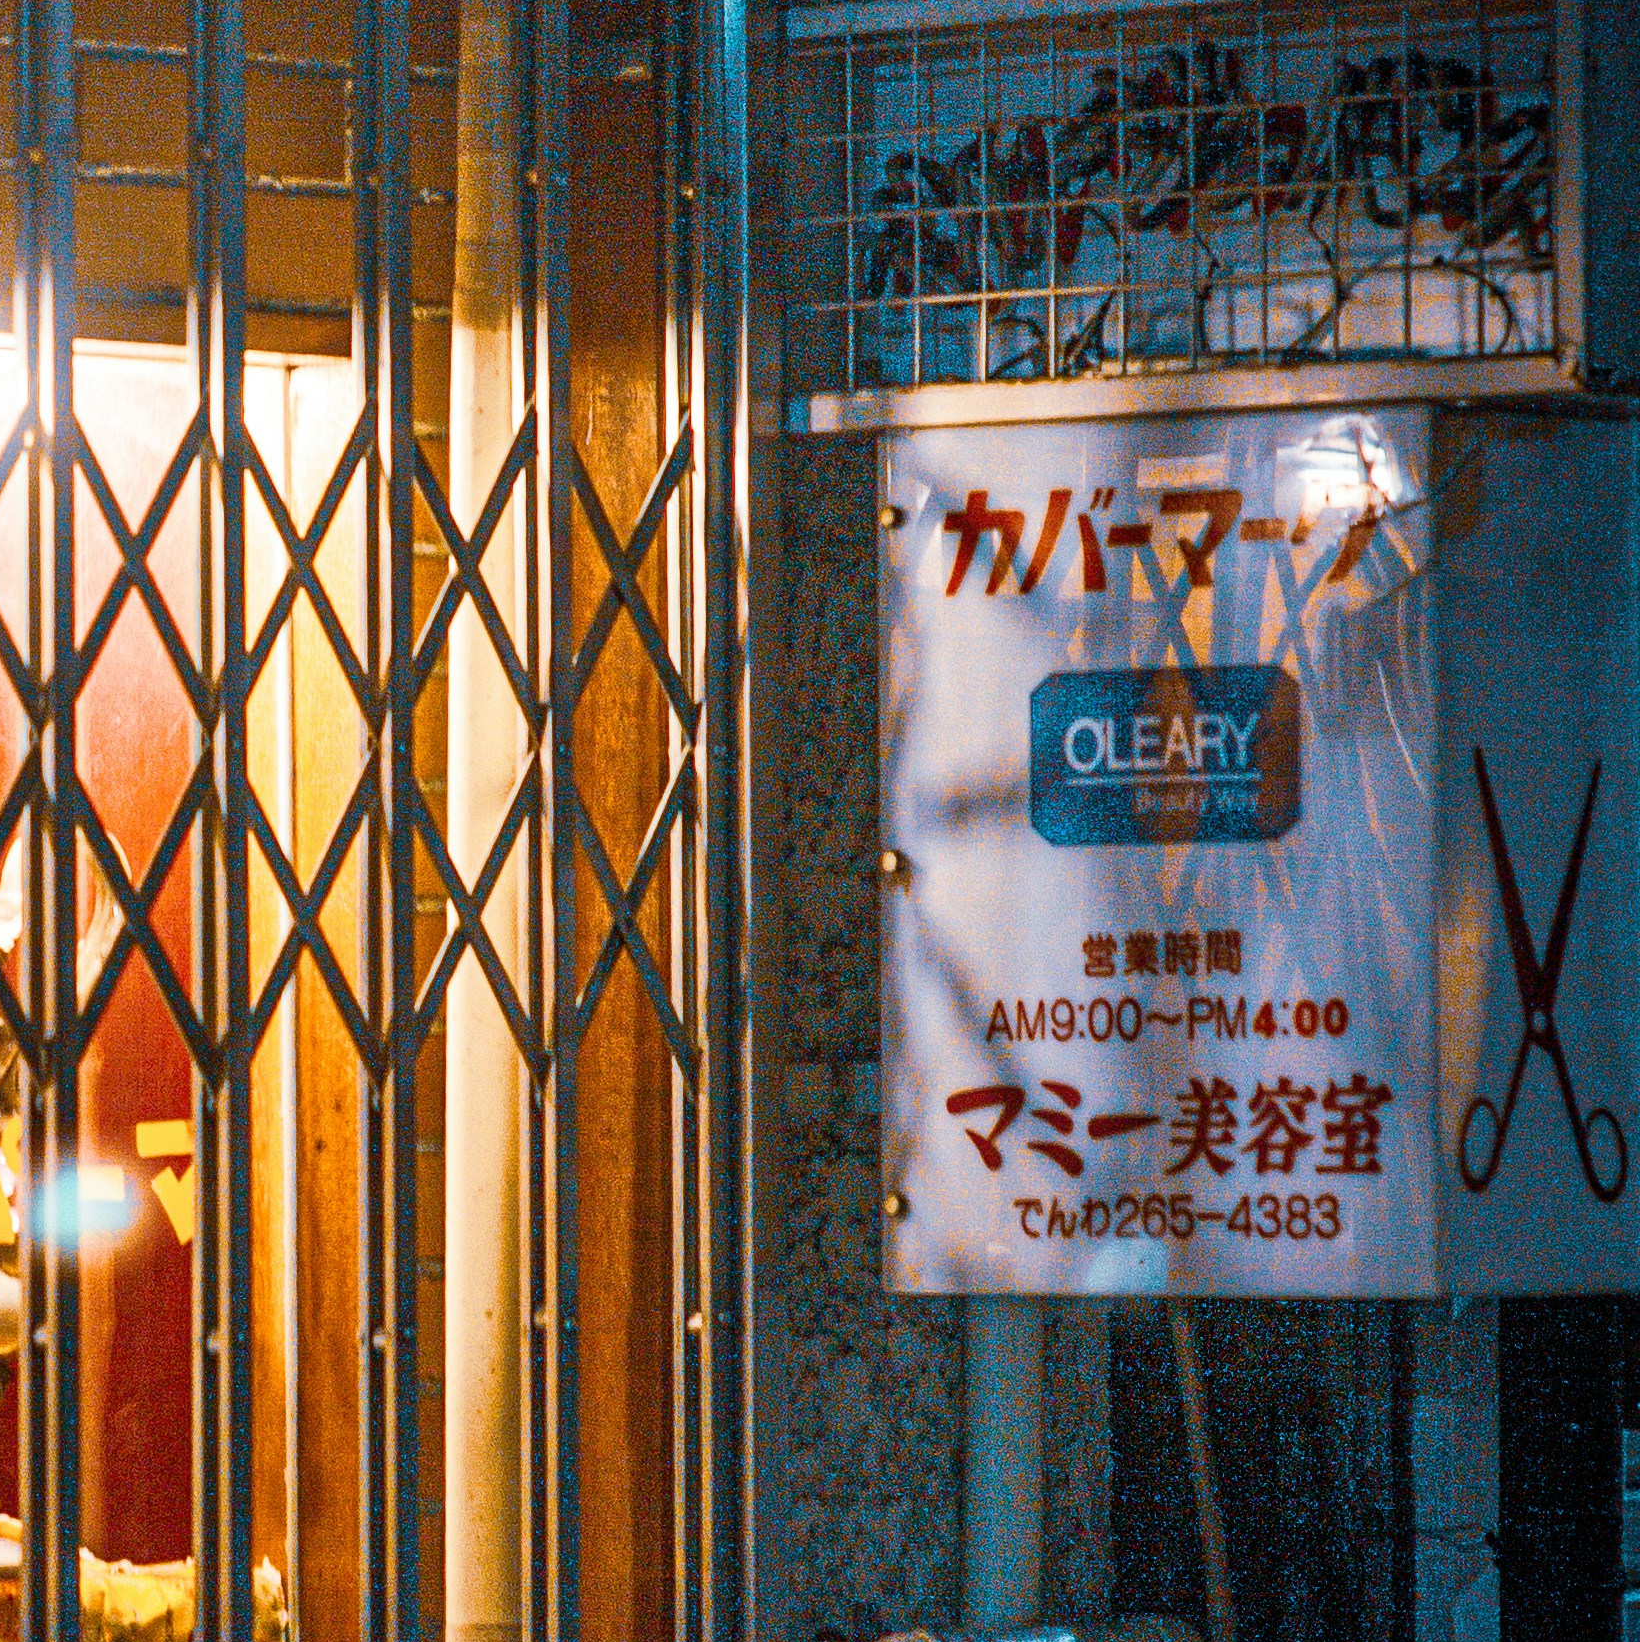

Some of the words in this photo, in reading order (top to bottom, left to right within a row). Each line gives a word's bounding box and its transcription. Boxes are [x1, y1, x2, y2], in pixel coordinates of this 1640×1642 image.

[1063, 711, 1260, 775] OLEARY
[1082, 929, 1243, 978] 営業時間
[945, 1074, 1394, 1178] マミー美容室
